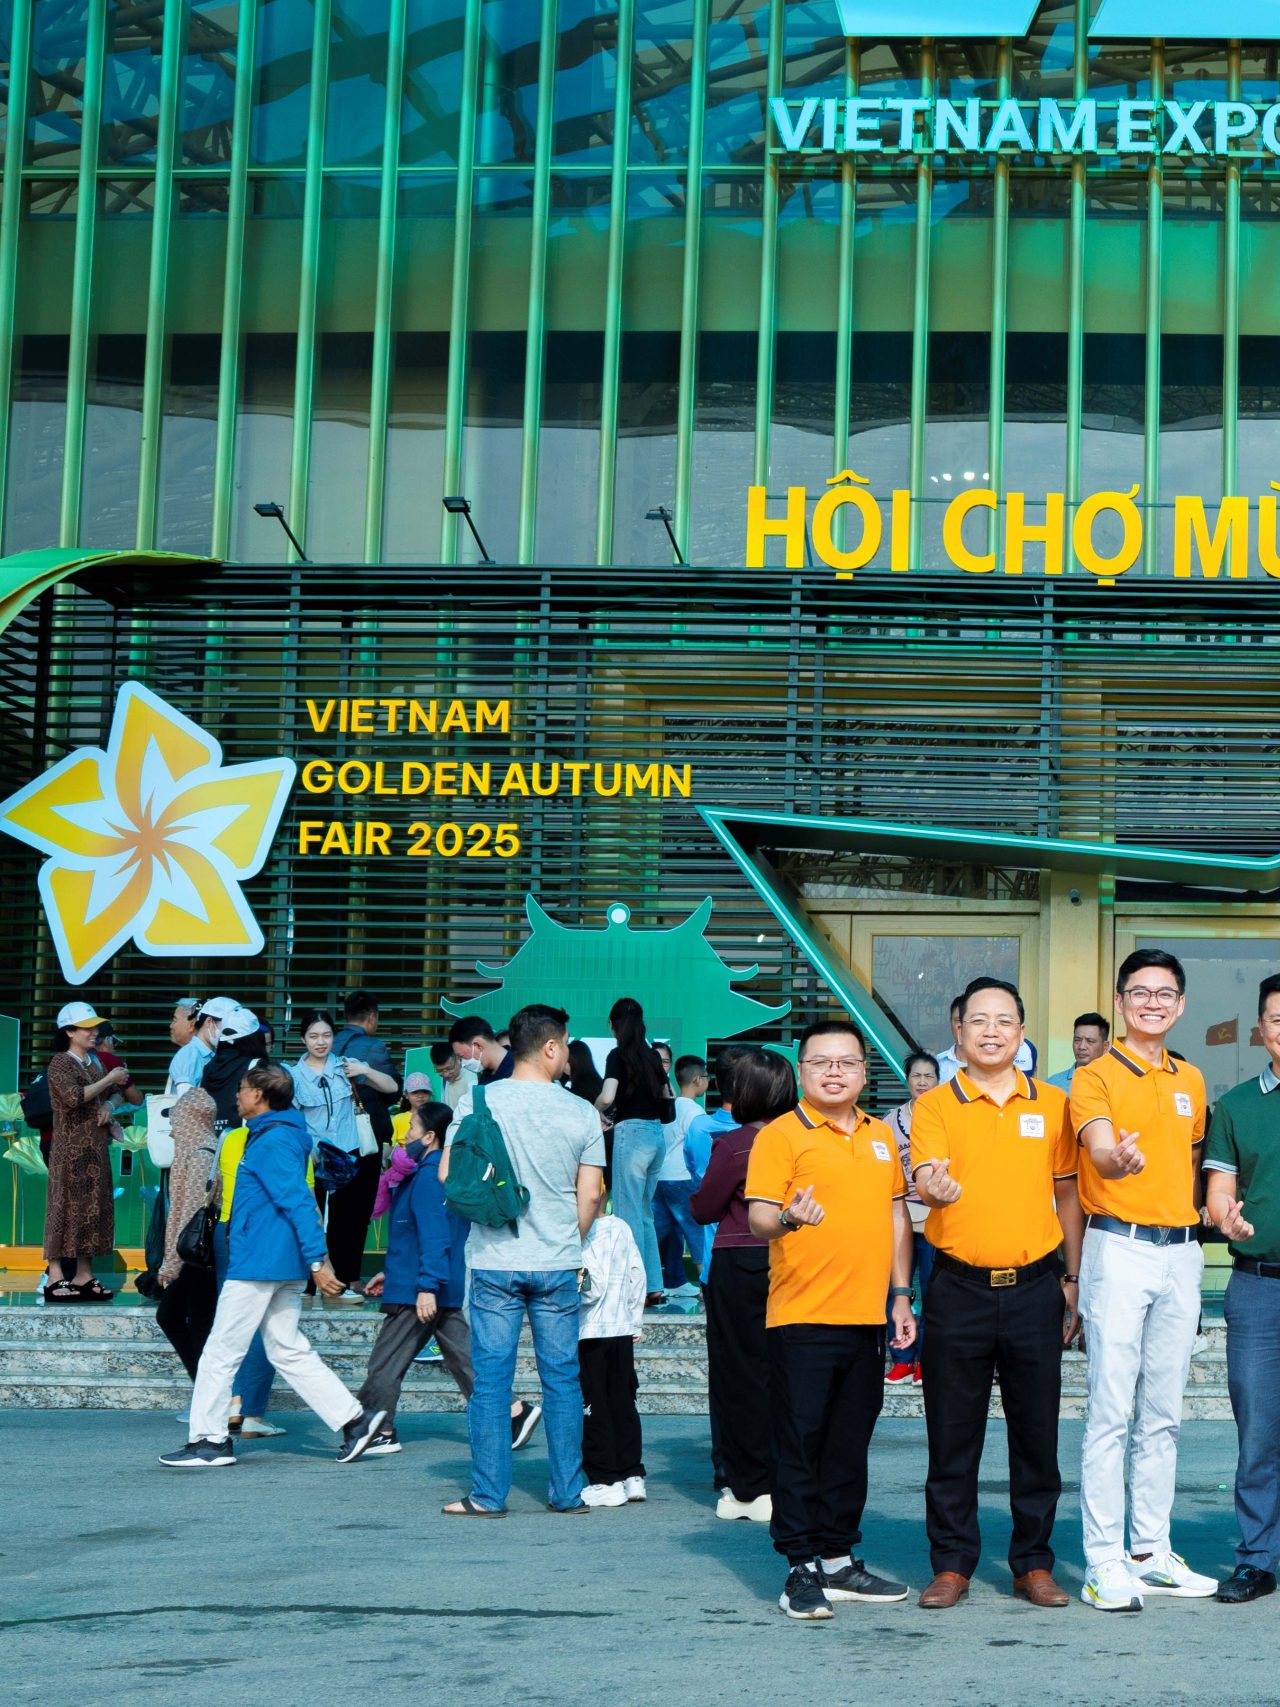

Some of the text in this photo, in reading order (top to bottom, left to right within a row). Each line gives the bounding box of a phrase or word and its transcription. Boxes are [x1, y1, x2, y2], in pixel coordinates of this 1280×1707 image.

[769, 96, 1097, 152] VIETNAM
[745, 469, 910, 580] HỘI
[942, 483, 1143, 586] CHỢ
[306, 699, 511, 734] VIETNAM
[301, 760, 692, 798] GOLDEN AUTUMN
[299, 821, 521, 857] FAIR 2025
